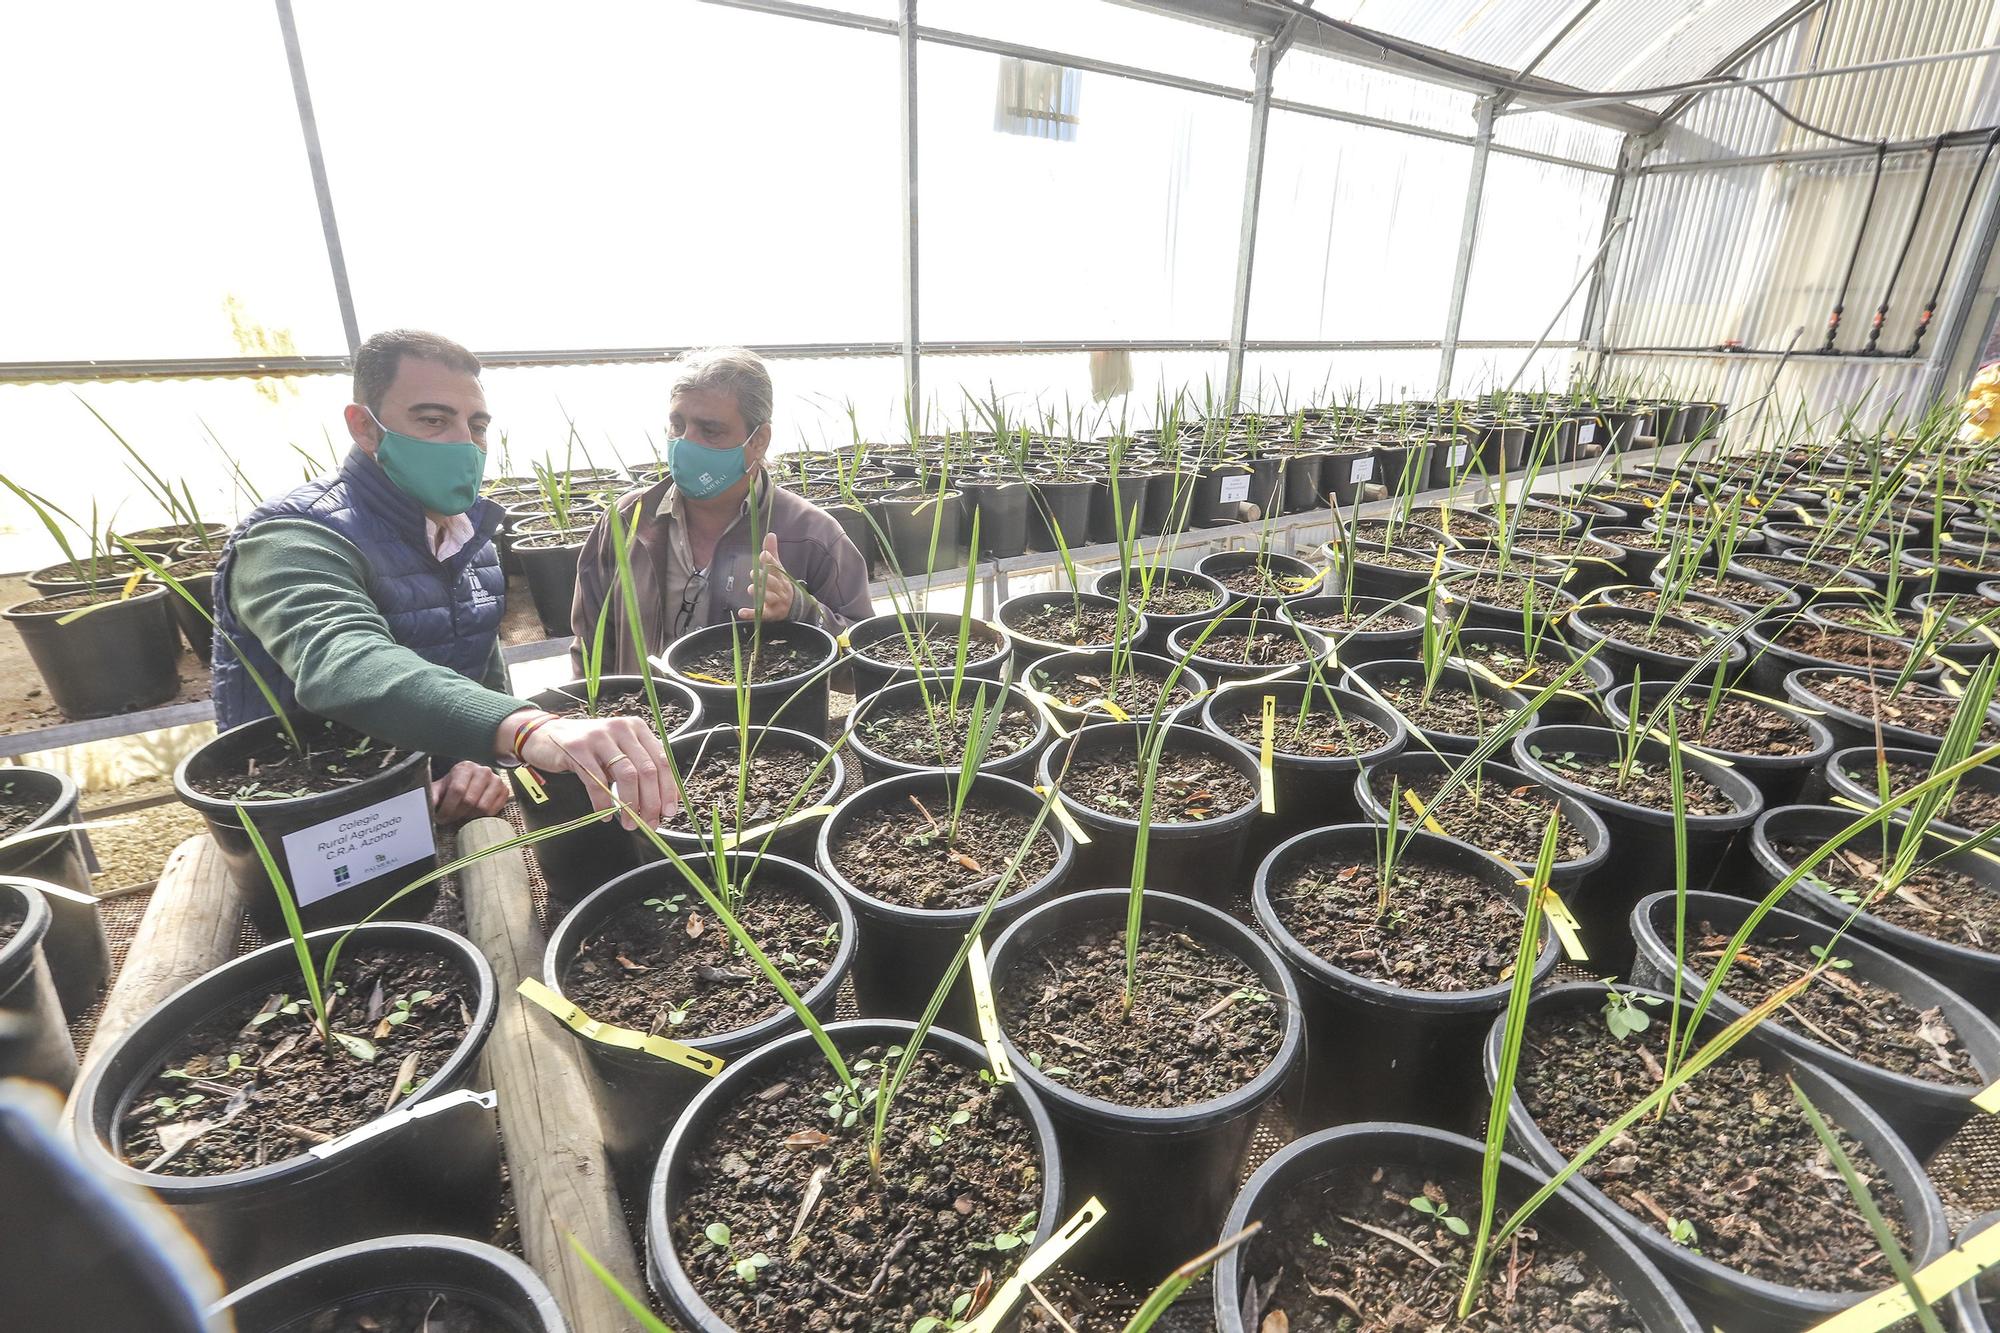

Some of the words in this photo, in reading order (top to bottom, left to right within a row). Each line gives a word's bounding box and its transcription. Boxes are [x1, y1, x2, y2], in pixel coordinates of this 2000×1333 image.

[317, 835, 348, 852] Rural
[350, 815, 402, 840] Agrupado
[338, 812, 380, 833] Colegio
[326, 843, 358, 860] C.R.A.
[360, 828, 399, 847] Azahar
